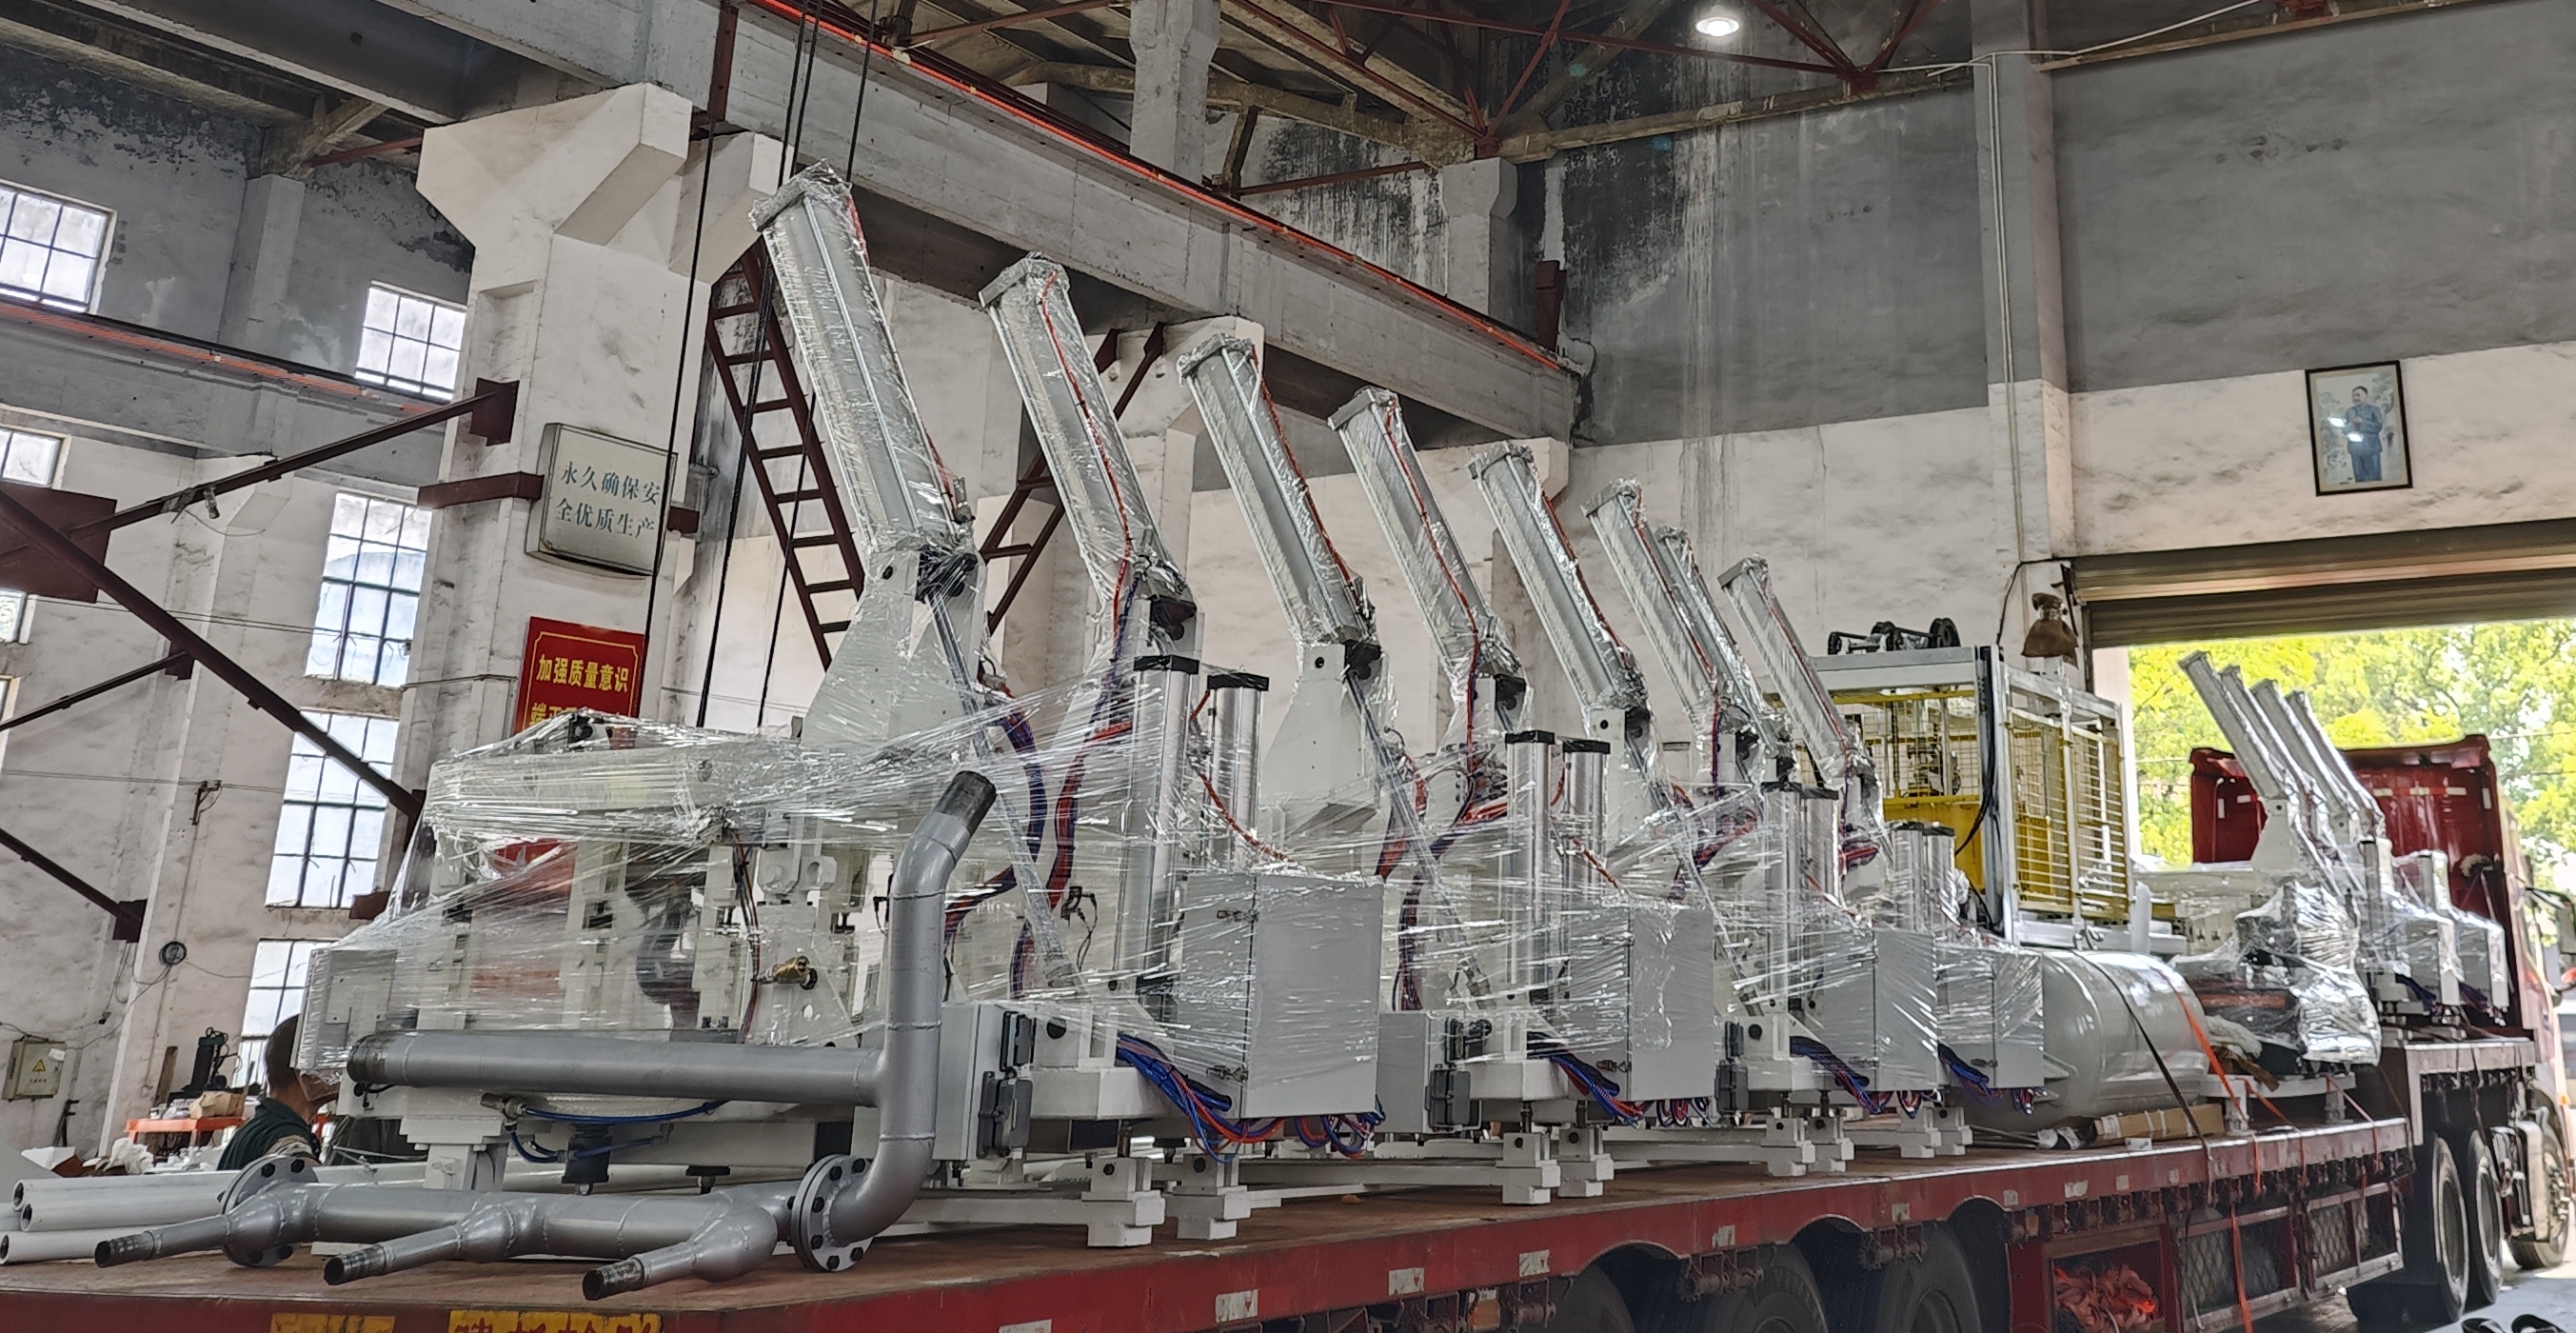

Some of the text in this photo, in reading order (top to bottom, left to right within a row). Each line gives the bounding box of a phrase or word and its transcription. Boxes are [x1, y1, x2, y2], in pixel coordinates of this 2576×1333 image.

[560, 461, 661, 506] 永久确保安
[554, 497, 655, 539] 全优质生产
[536, 653, 629, 693] 加强质量意识
